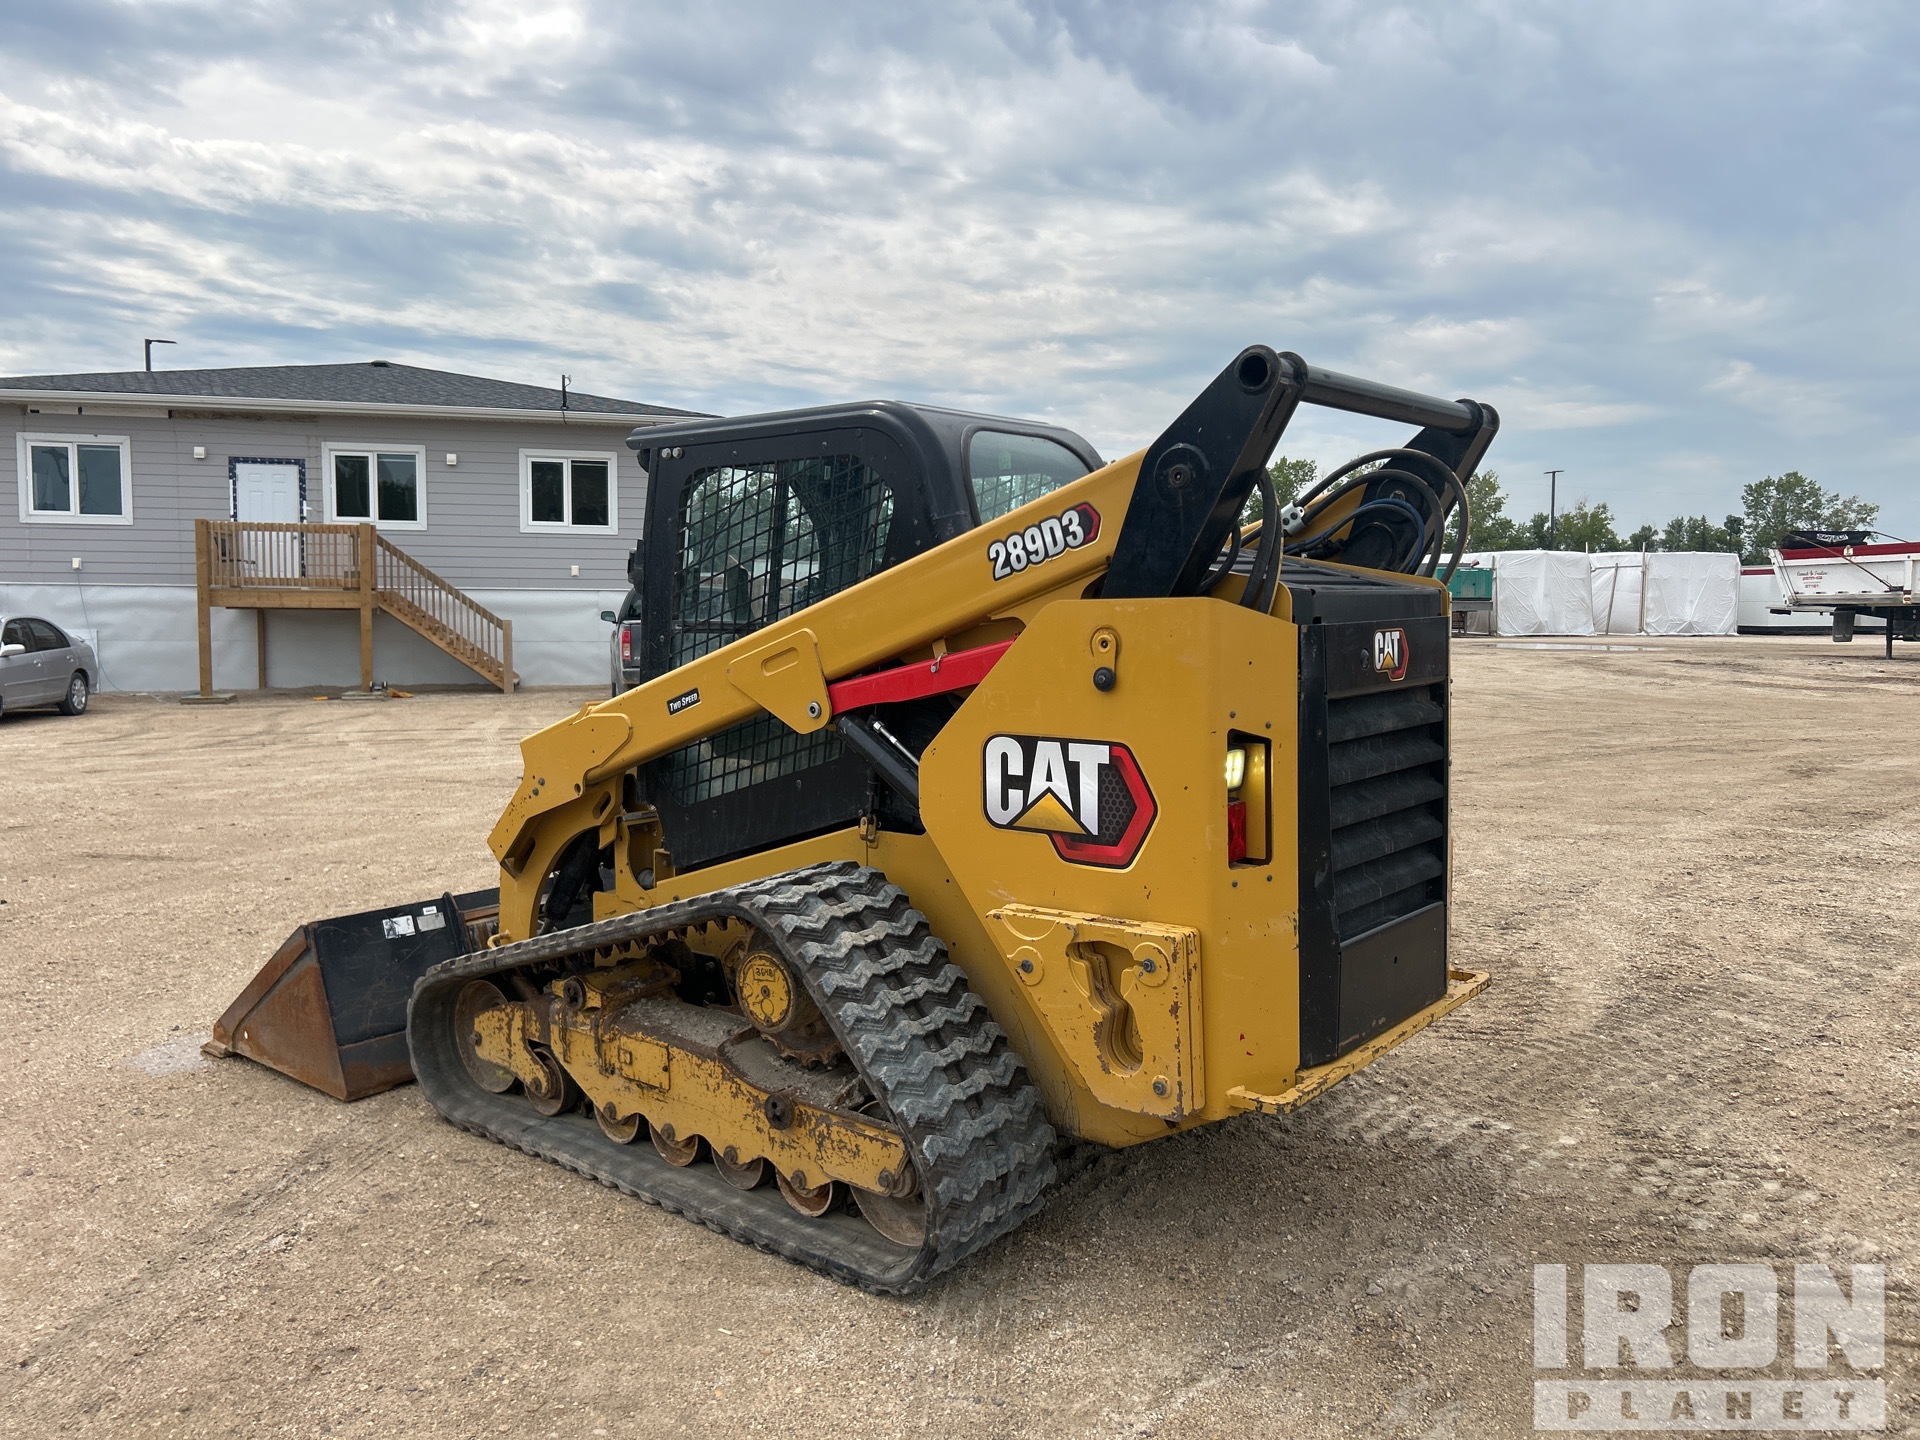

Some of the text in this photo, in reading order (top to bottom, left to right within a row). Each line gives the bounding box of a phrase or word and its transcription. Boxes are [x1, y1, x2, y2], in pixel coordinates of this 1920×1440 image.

[988, 510, 1085, 579] 289D3
[1374, 631, 1400, 670] CAT
[985, 736, 1110, 836] CAT
